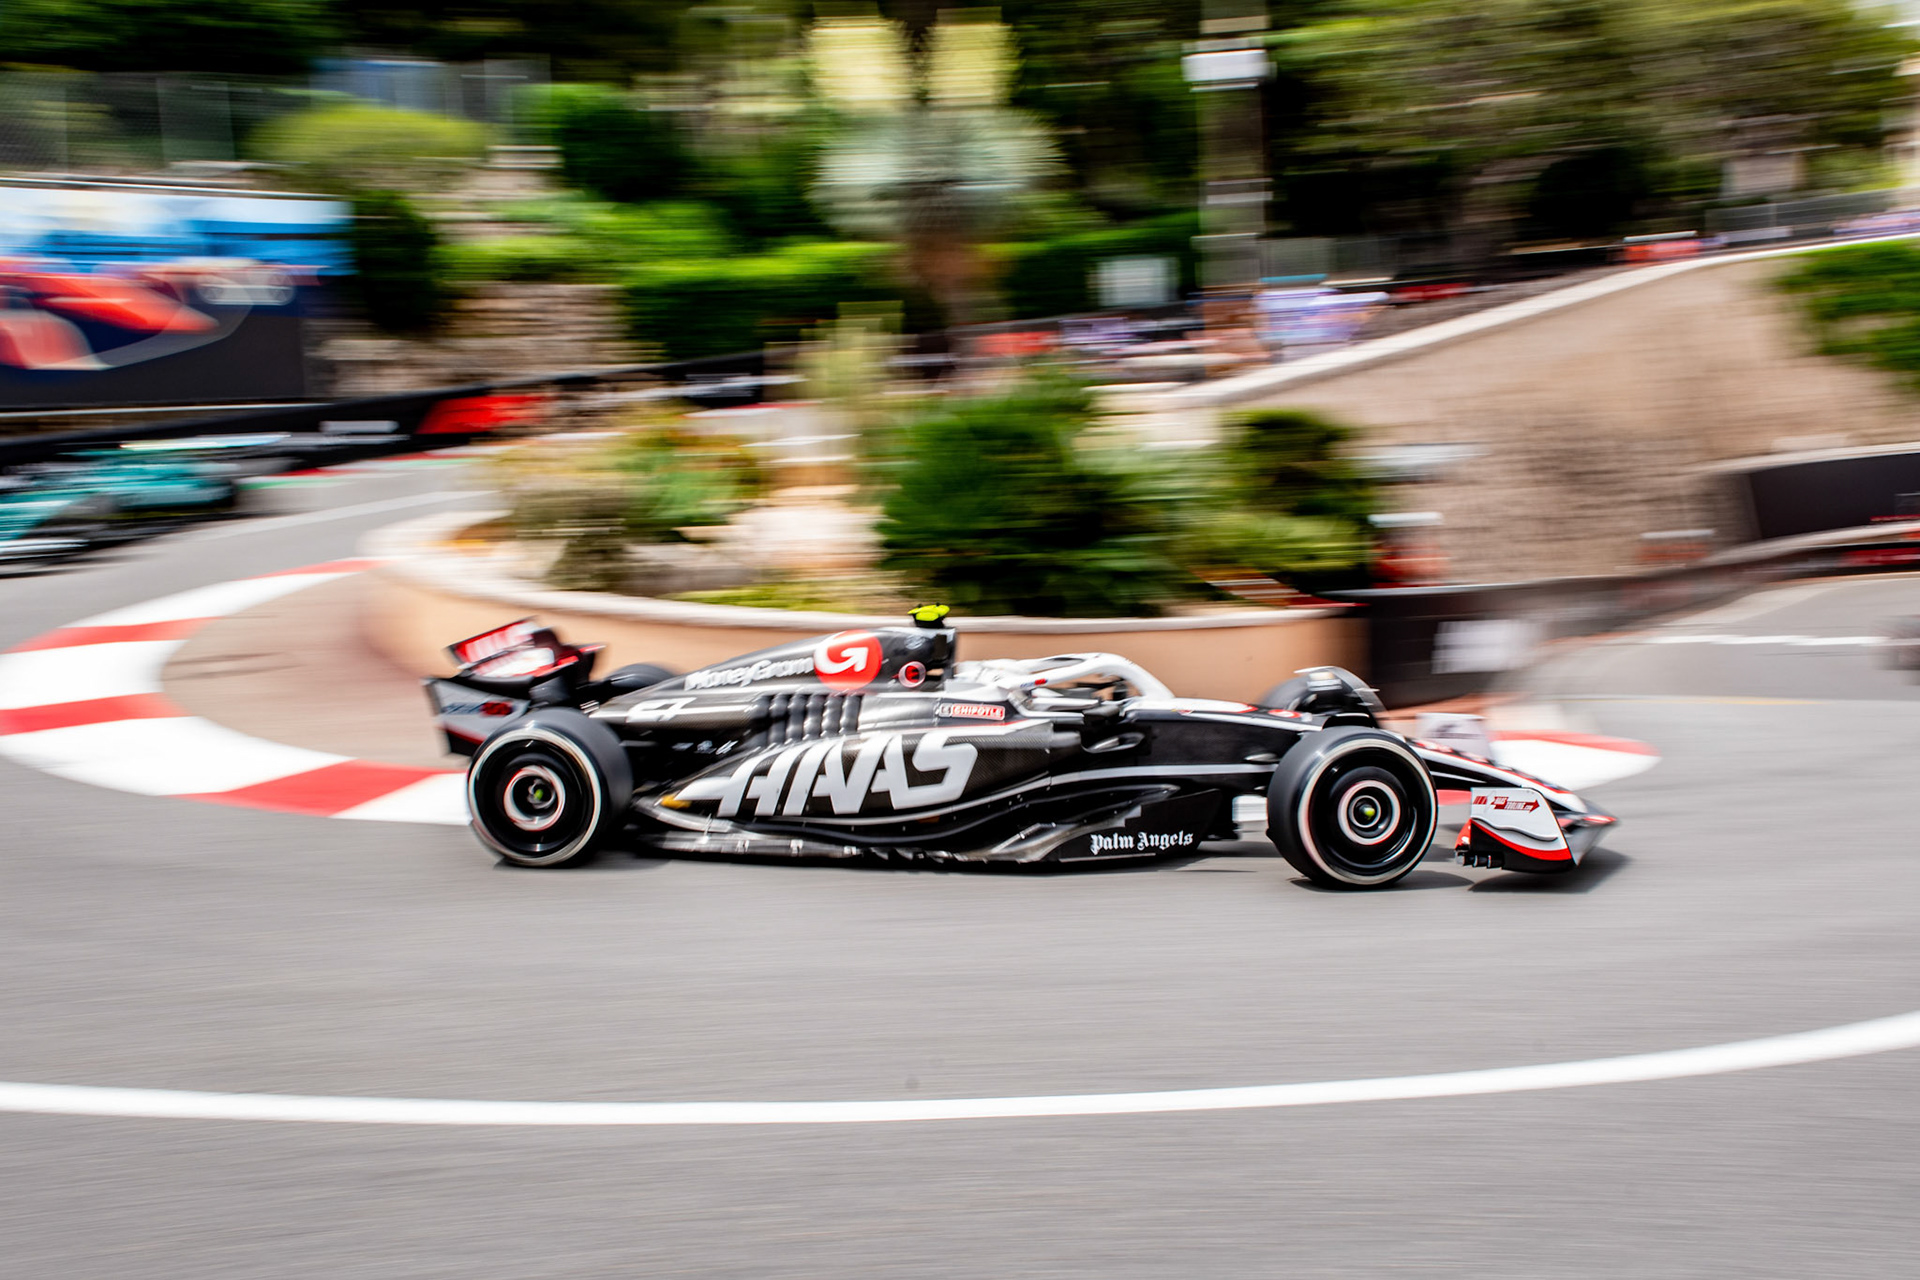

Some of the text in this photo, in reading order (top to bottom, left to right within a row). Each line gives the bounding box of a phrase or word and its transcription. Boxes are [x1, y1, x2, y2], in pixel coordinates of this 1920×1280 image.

[684, 658, 814, 691] MoneyGram
[953, 705, 1003, 718] CHIPOTLE
[674, 731, 979, 817] HAAS
[1090, 830, 1194, 856] Palm Angels
